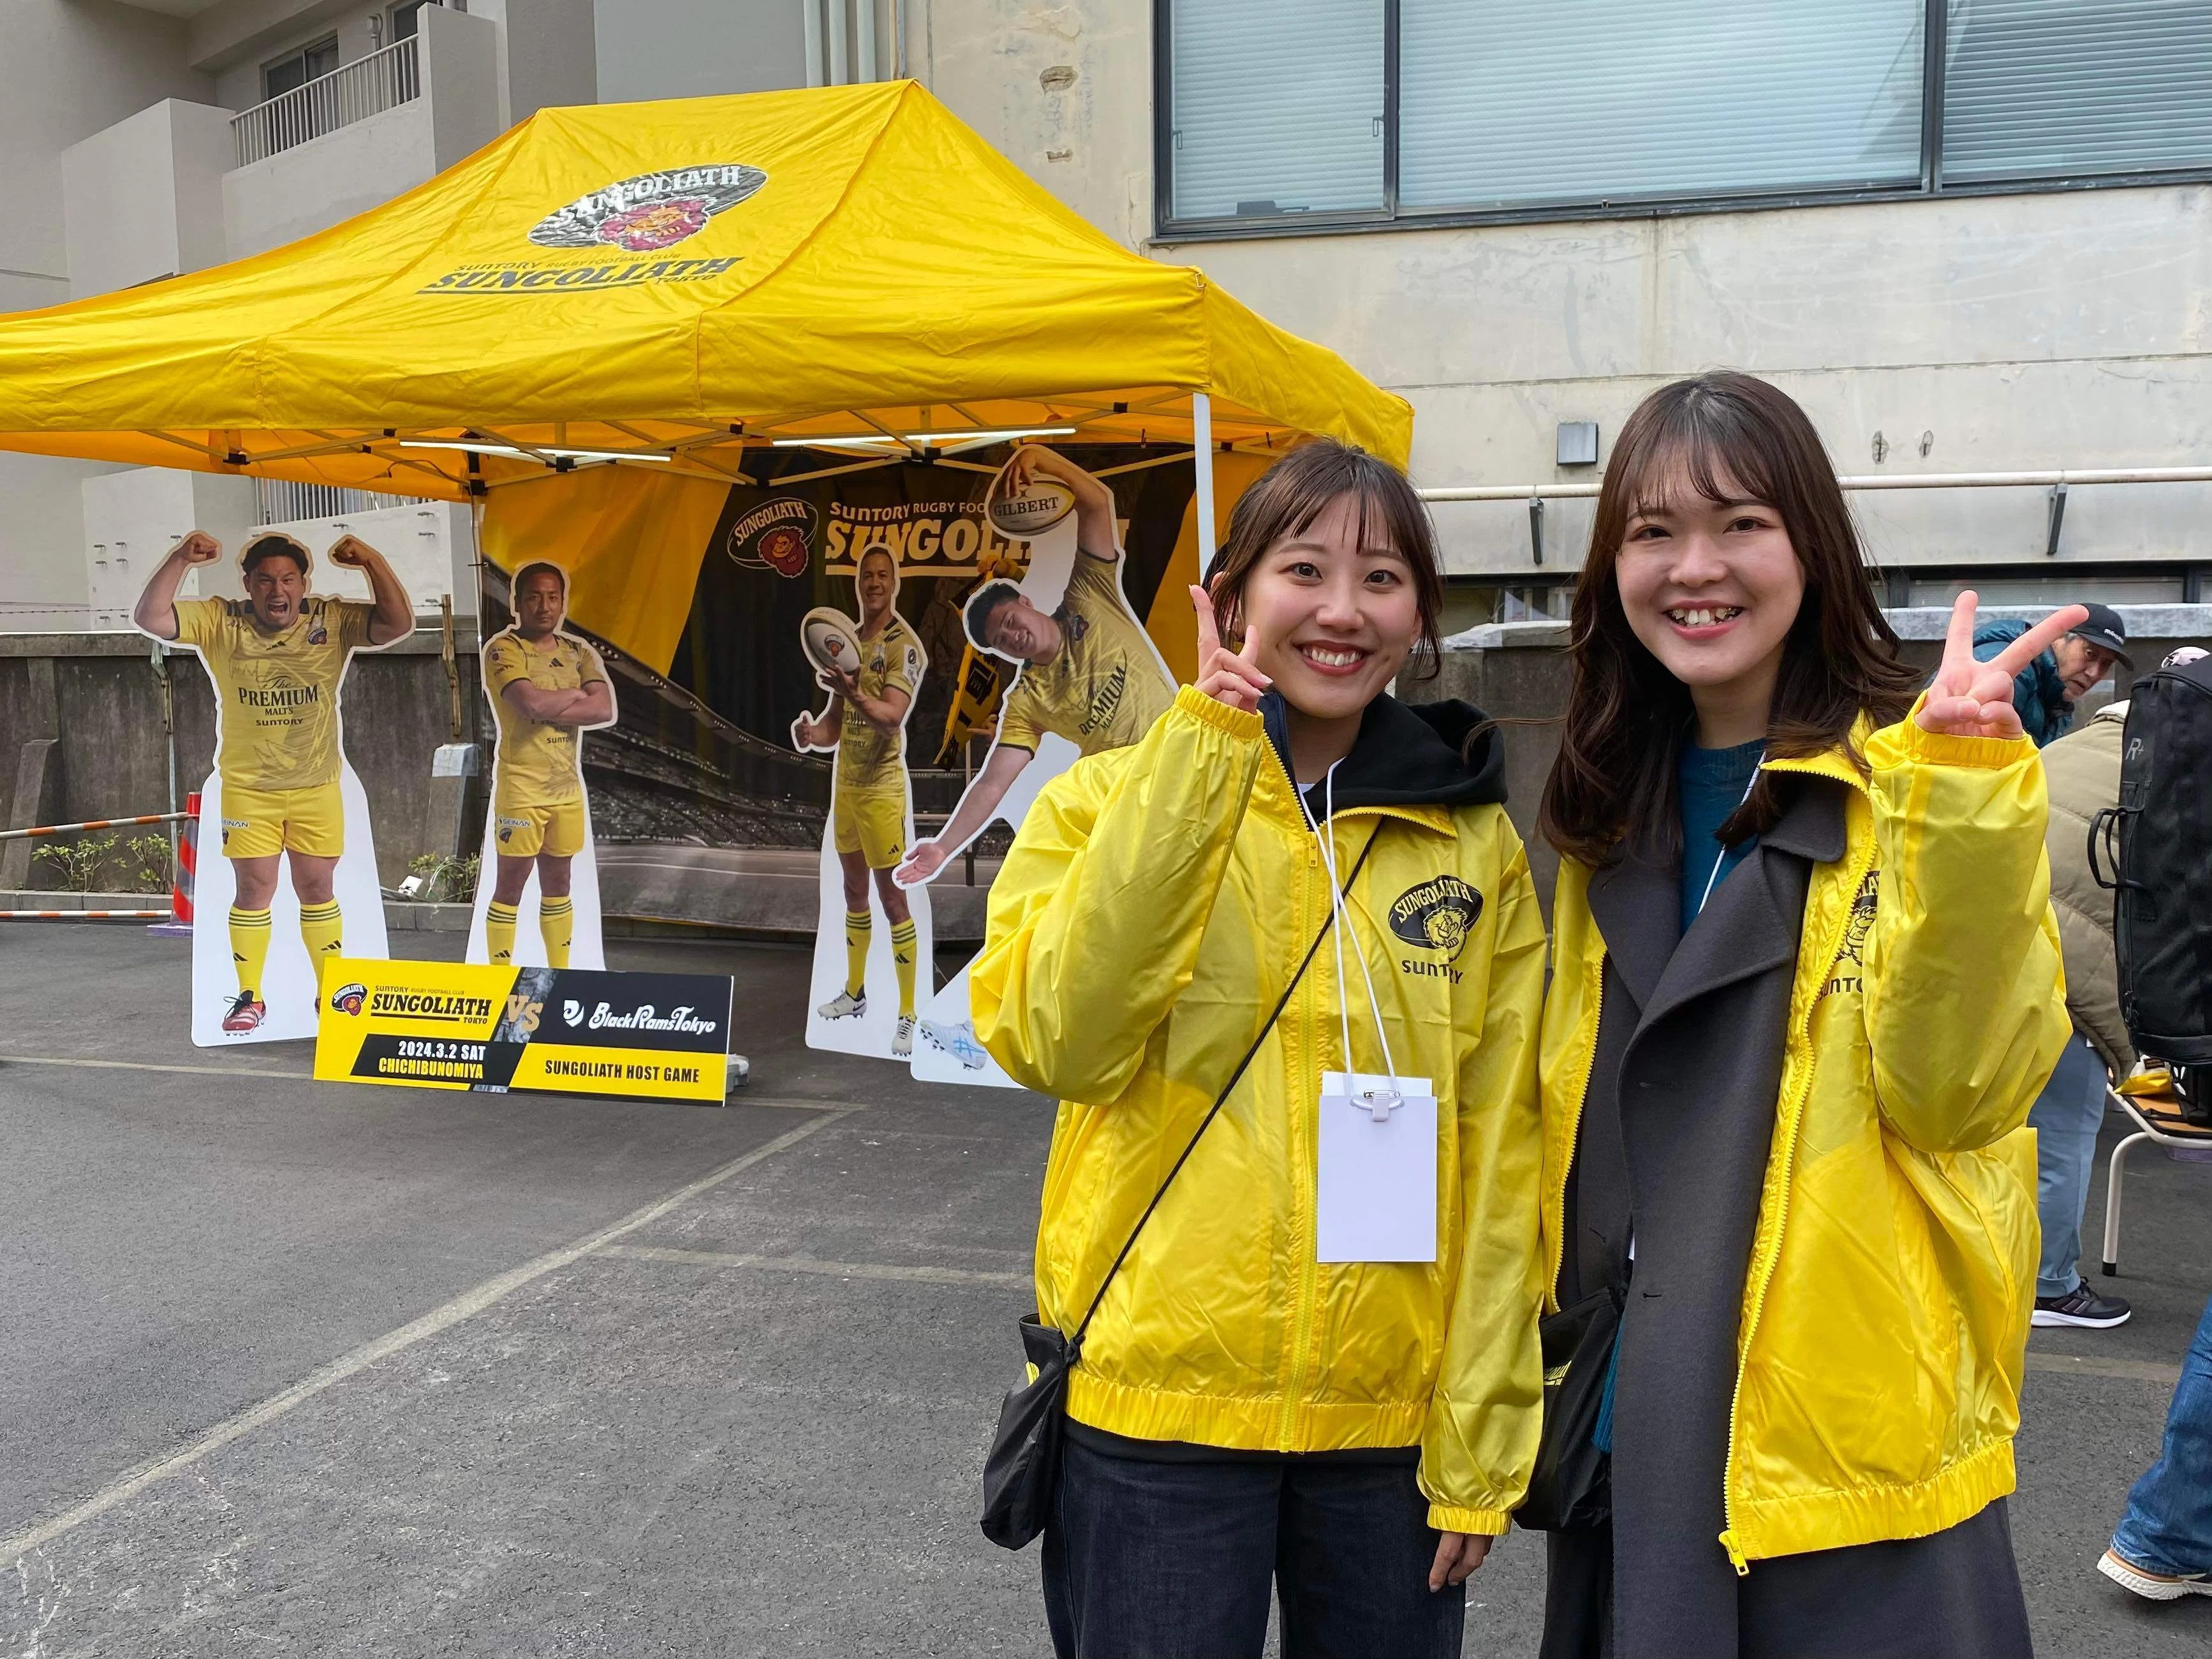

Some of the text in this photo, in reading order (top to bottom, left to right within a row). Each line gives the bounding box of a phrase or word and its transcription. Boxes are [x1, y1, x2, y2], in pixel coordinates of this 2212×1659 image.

[559, 166, 741, 223] SUNGOLIATH
[425, 256, 745, 288] SUNGOLIATH
[455, 261, 542, 271] SUNTORY
[589, 255, 647, 265] FOOTBALL
[654, 274, 717, 284] TOKYO
[830, 501, 910, 521] SUNTORY
[913, 502, 955, 513] RUGBY
[994, 497, 1059, 517] GILBERT
[735, 501, 807, 547] SUNGOLIATH
[263, 675, 291, 689] The
[238, 684, 318, 707] PREMIUM
[503, 818, 531, 827] SEINAN
[1394, 880, 1473, 924] SUNGOLIATH
[371, 994, 492, 1017] SUNGOLIATH
[508, 994, 543, 1031] VS
[398, 1040, 486, 1061] 2024.3.2 SAT
[378, 1058, 483, 1079] CHICHIBUNOMIYA
[545, 1059, 700, 1083] SUNGOLIATH HOST GAME
